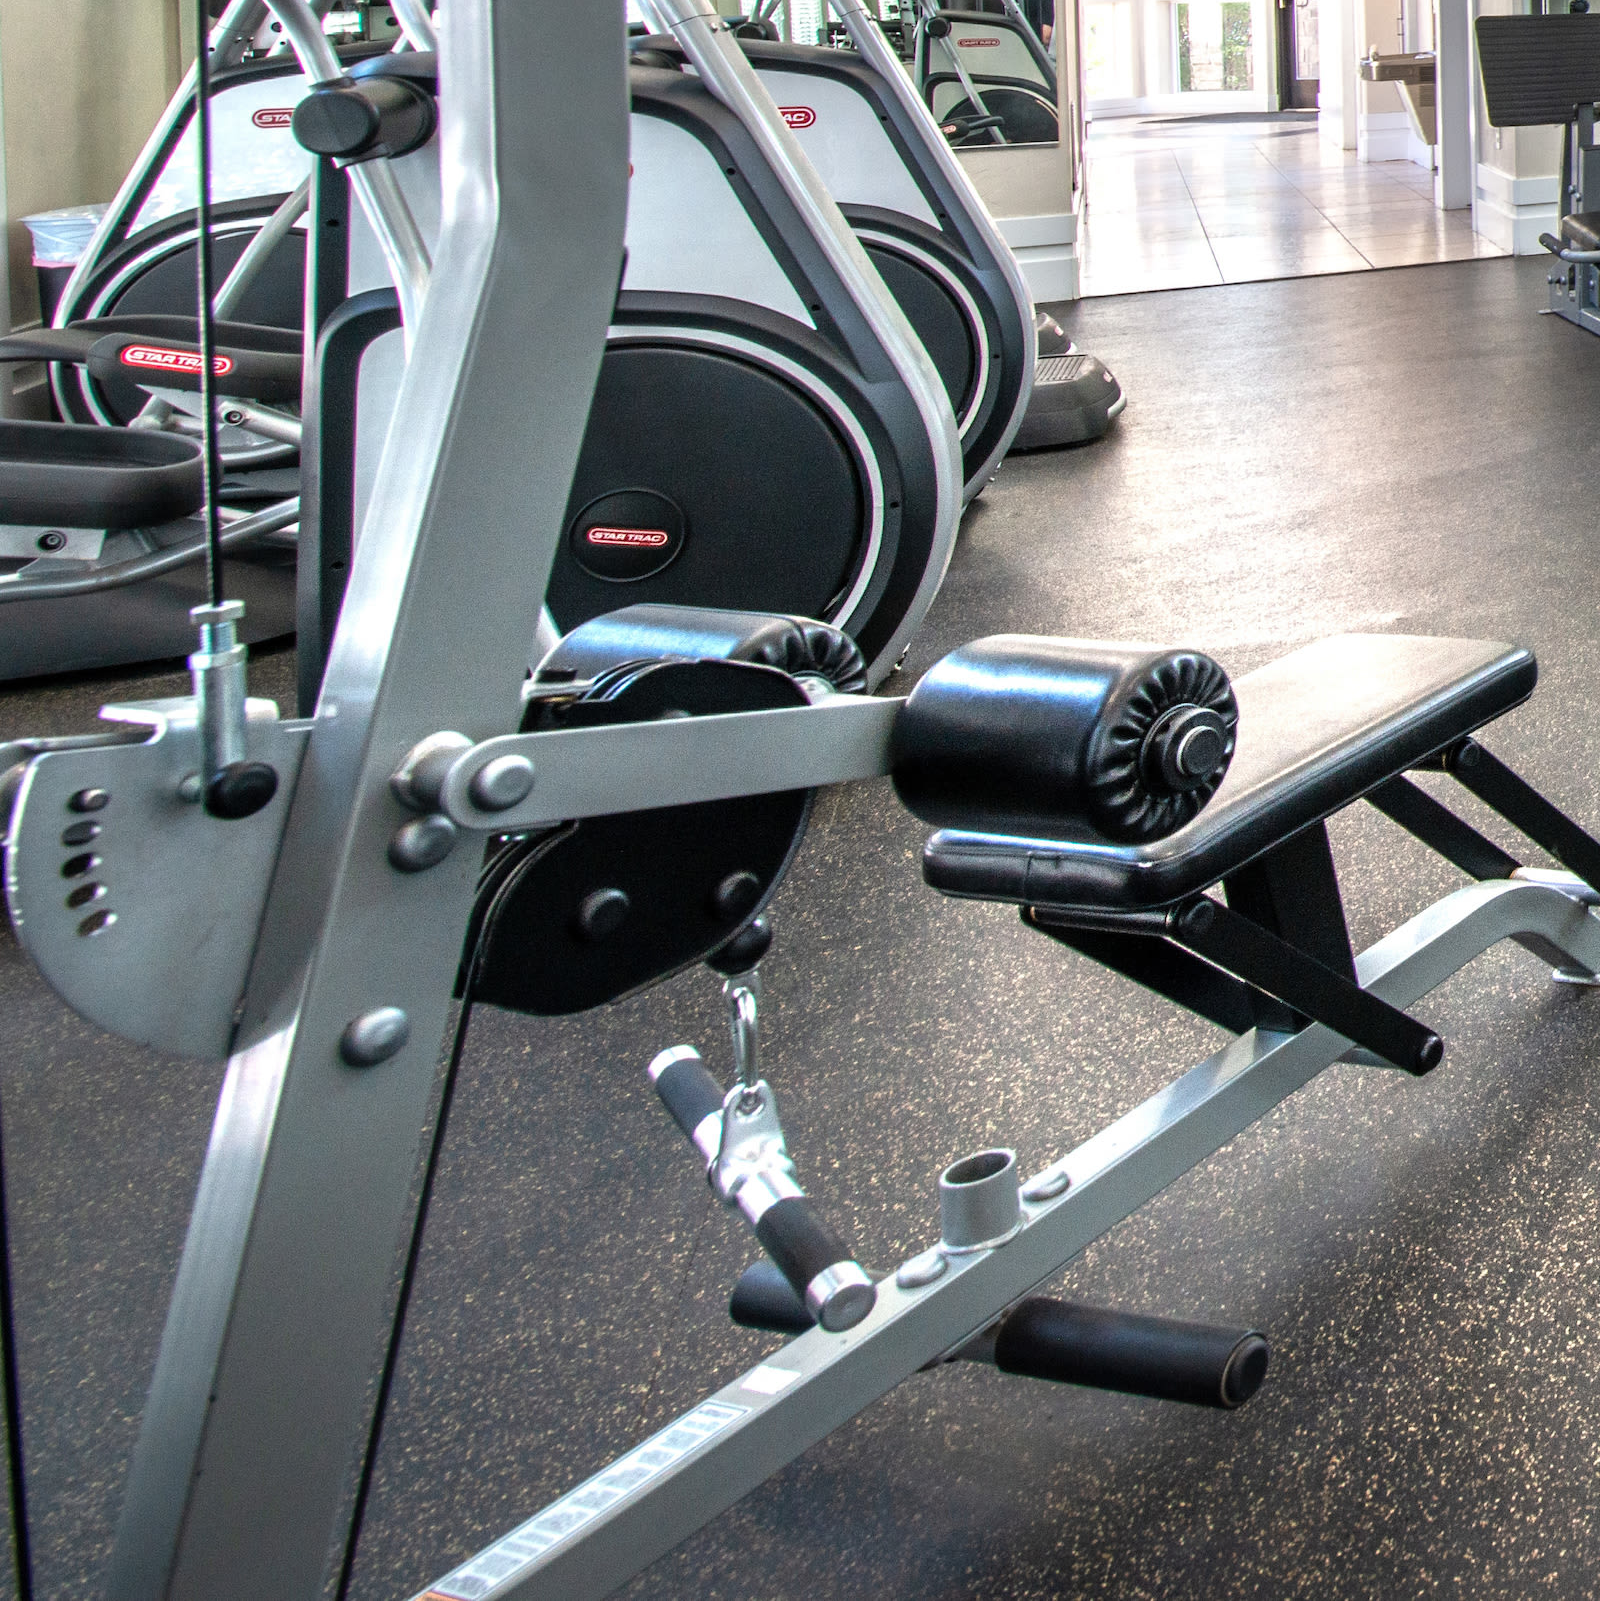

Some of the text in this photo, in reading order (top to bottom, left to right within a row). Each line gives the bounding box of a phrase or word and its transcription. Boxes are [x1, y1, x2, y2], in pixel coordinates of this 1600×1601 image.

[783, 113, 805, 122] AC
[130, 351, 176, 364] STAR
[592, 532, 662, 542] STAR TRAC
